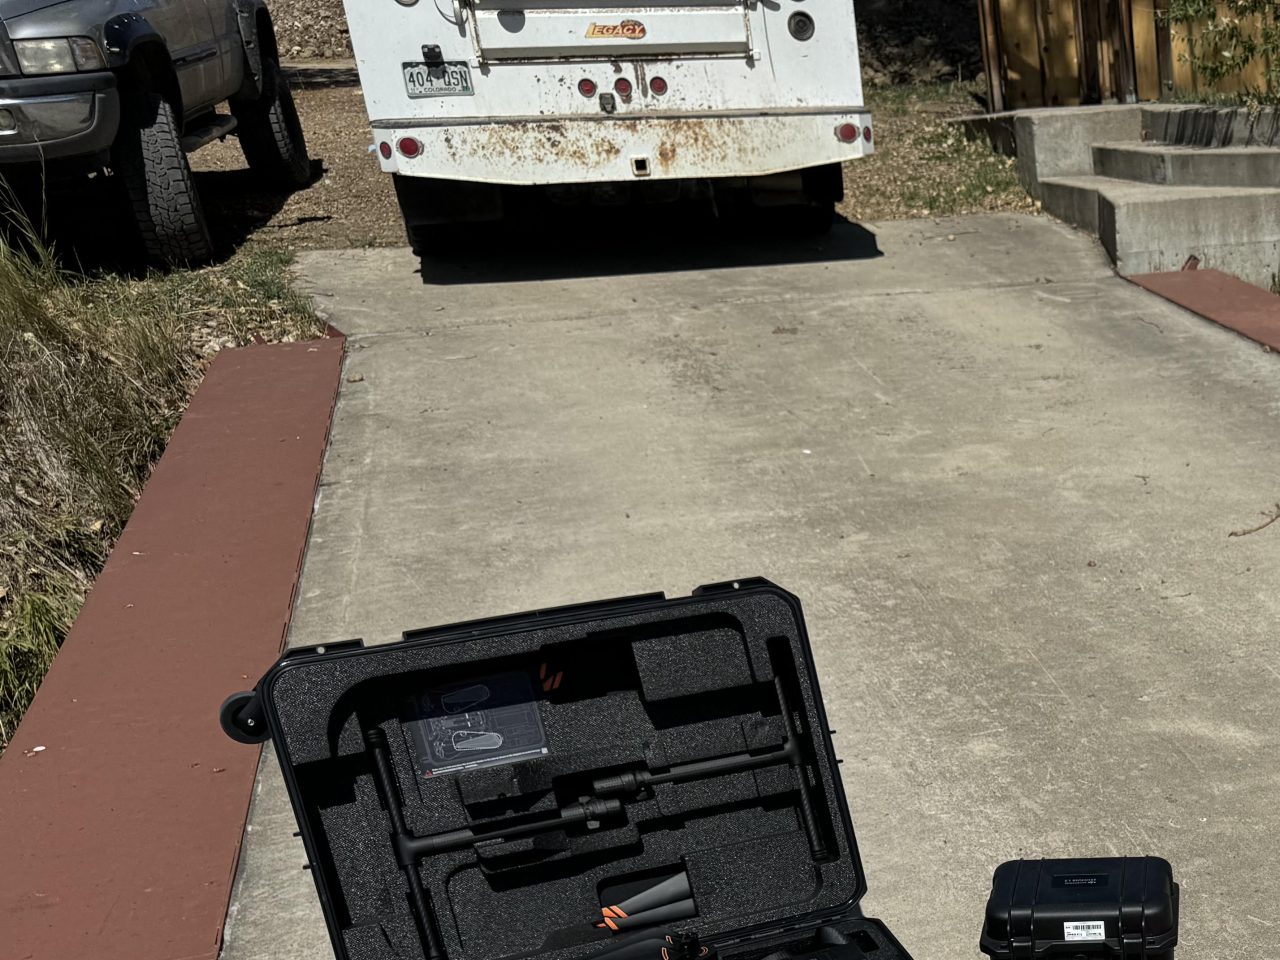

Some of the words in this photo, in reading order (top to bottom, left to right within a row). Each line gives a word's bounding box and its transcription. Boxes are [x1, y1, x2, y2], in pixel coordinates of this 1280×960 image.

[585, 22, 643, 38] LEGACY
[408, 70, 433, 87] 404
[443, 70, 469, 87] QSN
